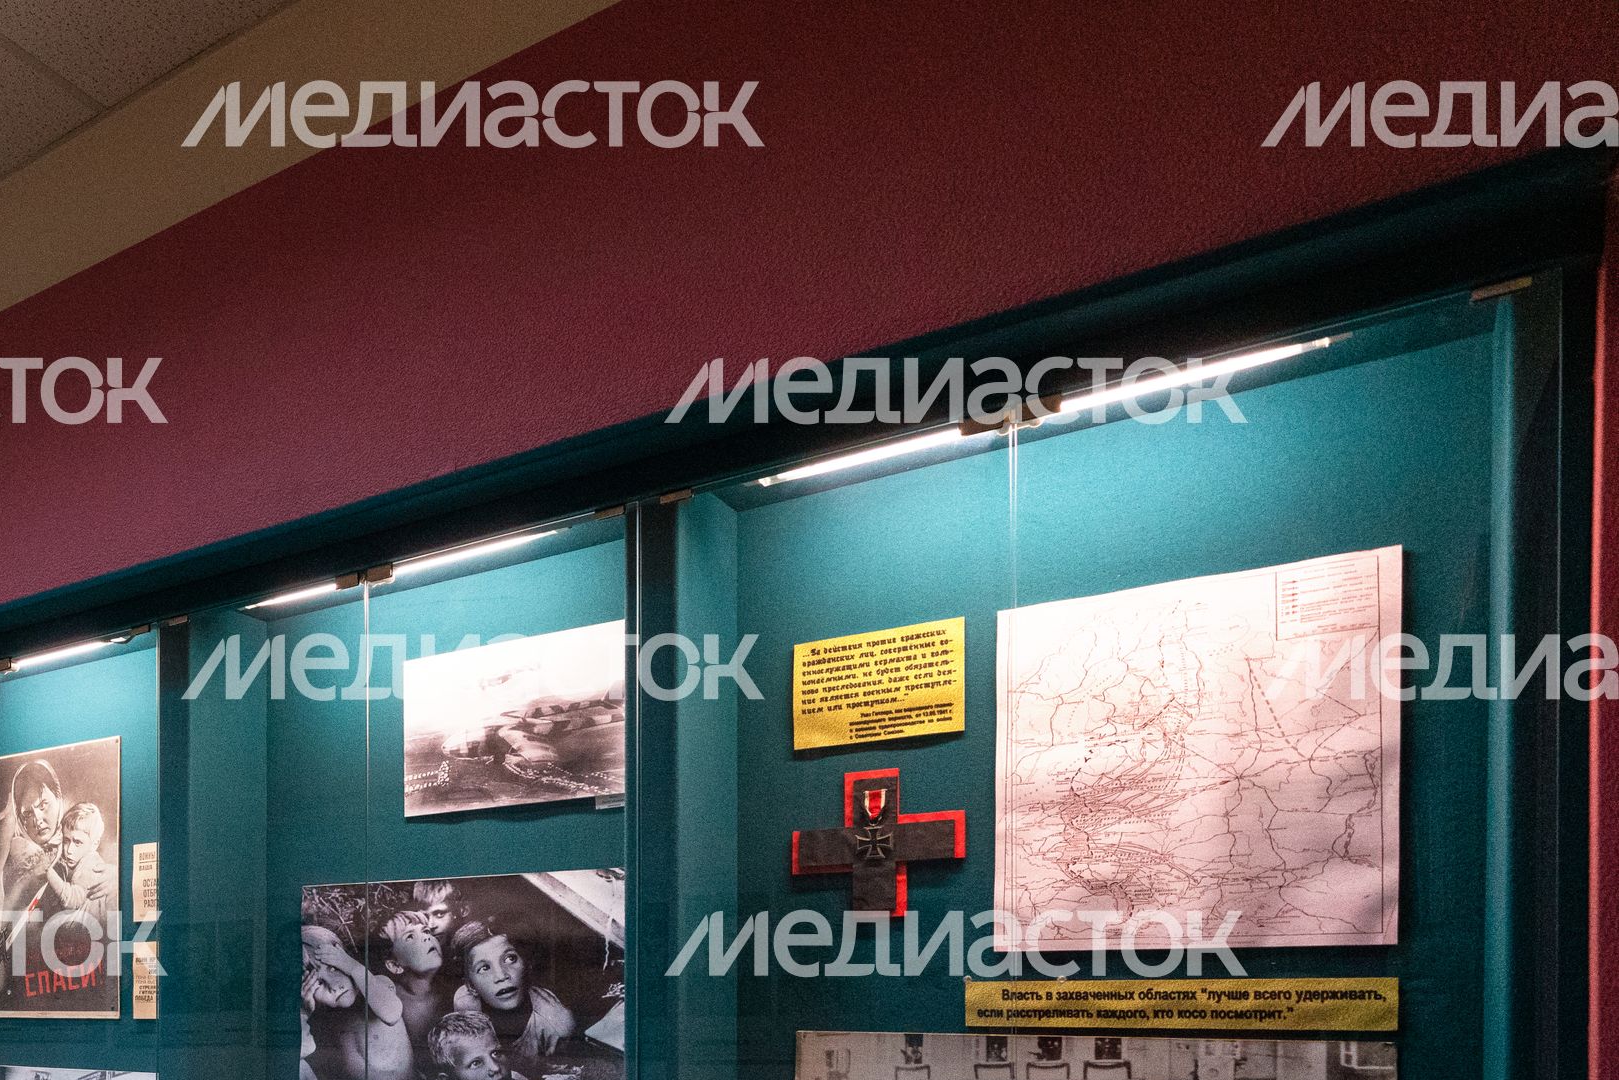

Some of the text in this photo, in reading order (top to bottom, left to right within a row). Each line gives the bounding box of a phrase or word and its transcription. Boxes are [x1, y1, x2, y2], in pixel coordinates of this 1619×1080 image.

[862, 670, 873, 678] не
[876, 667, 901, 677] будет
[888, 674, 910, 684] даже
[914, 671, 933, 680] если
[1001, 988, 1043, 1001] Власть
[1046, 992, 1053, 1001] в
[1056, 991, 1135, 1001] захваченных
[1138, 988, 1197, 1001] областях
[1254, 990, 1292, 1001] всего
[1295, 989, 1386, 1004] удерживать,
[977, 1008, 1003, 1018] если
[1006, 1008, 1093, 1022] расстреливать
[1096, 1008, 1150, 1021] каждого,
[1153, 1008, 1174, 1019] кто
[1177, 1008, 1207, 1019] косо
